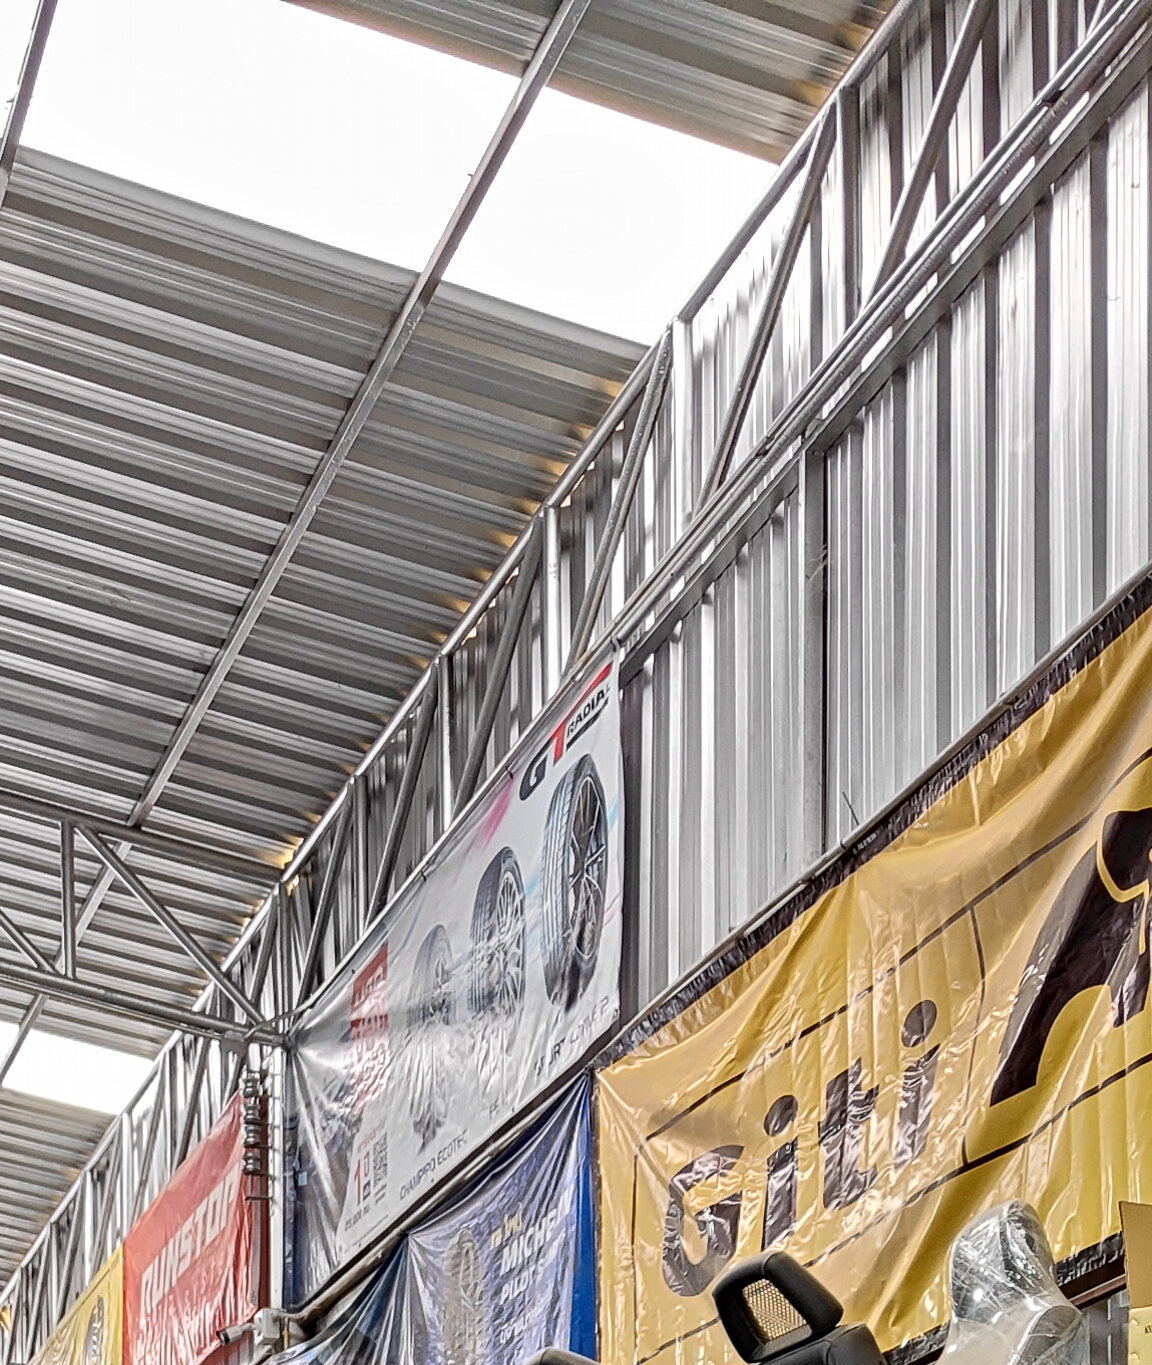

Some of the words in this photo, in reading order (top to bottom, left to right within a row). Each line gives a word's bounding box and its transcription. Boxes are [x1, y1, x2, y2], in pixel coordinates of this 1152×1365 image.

[567, 682, 611, 739] RADIAL
[662, 999, 940, 1297] Giti
[142, 1162, 240, 1315] RUNSTOP
